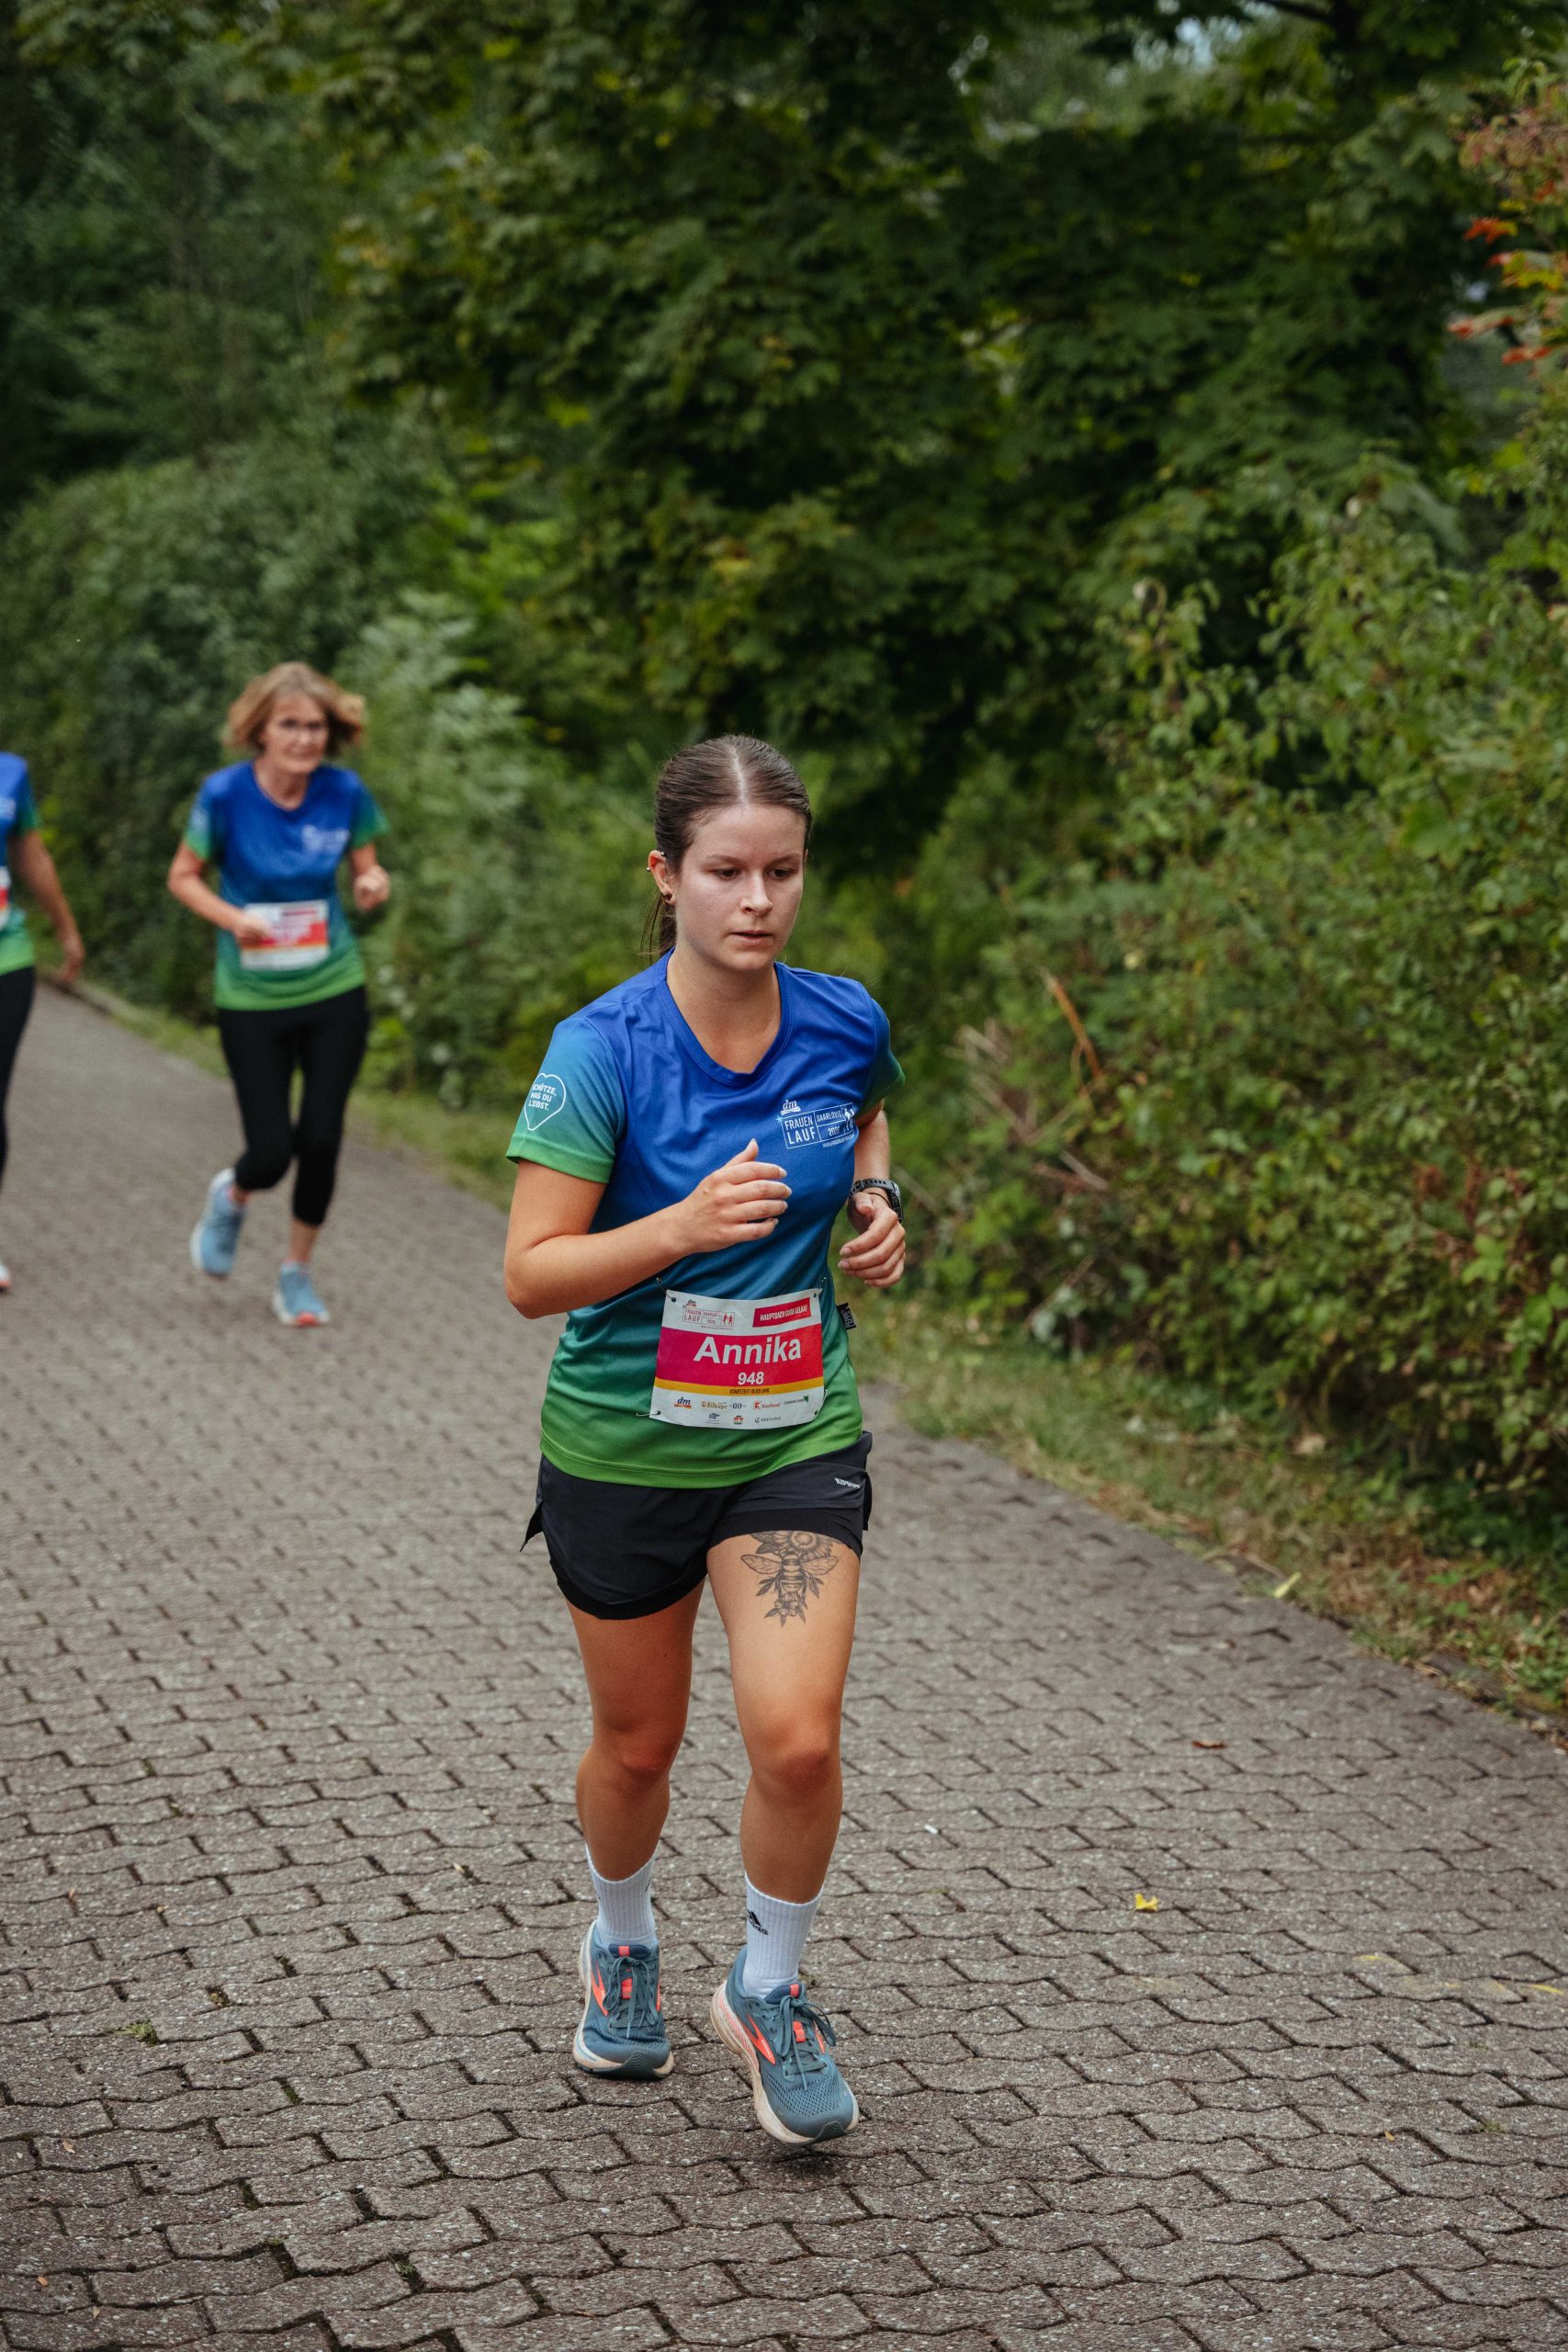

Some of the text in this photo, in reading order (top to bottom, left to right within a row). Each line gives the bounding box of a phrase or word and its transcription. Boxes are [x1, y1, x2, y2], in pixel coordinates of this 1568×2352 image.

[542, 1094, 552, 1102] DU
[528, 1100, 549, 1111] LIEBST.
[783, 1100, 797, 1111] dm
[784, 1115, 814, 1131] FRAUEN
[787, 1126, 816, 1145] LAUF
[684, 1314, 701, 1322] LAUF
[760, 1310, 785, 1321] HAUPTSACH
[693, 1336, 801, 1364] Annika
[738, 1371, 764, 1385] 948
[677, 1396, 691, 1405] dm
